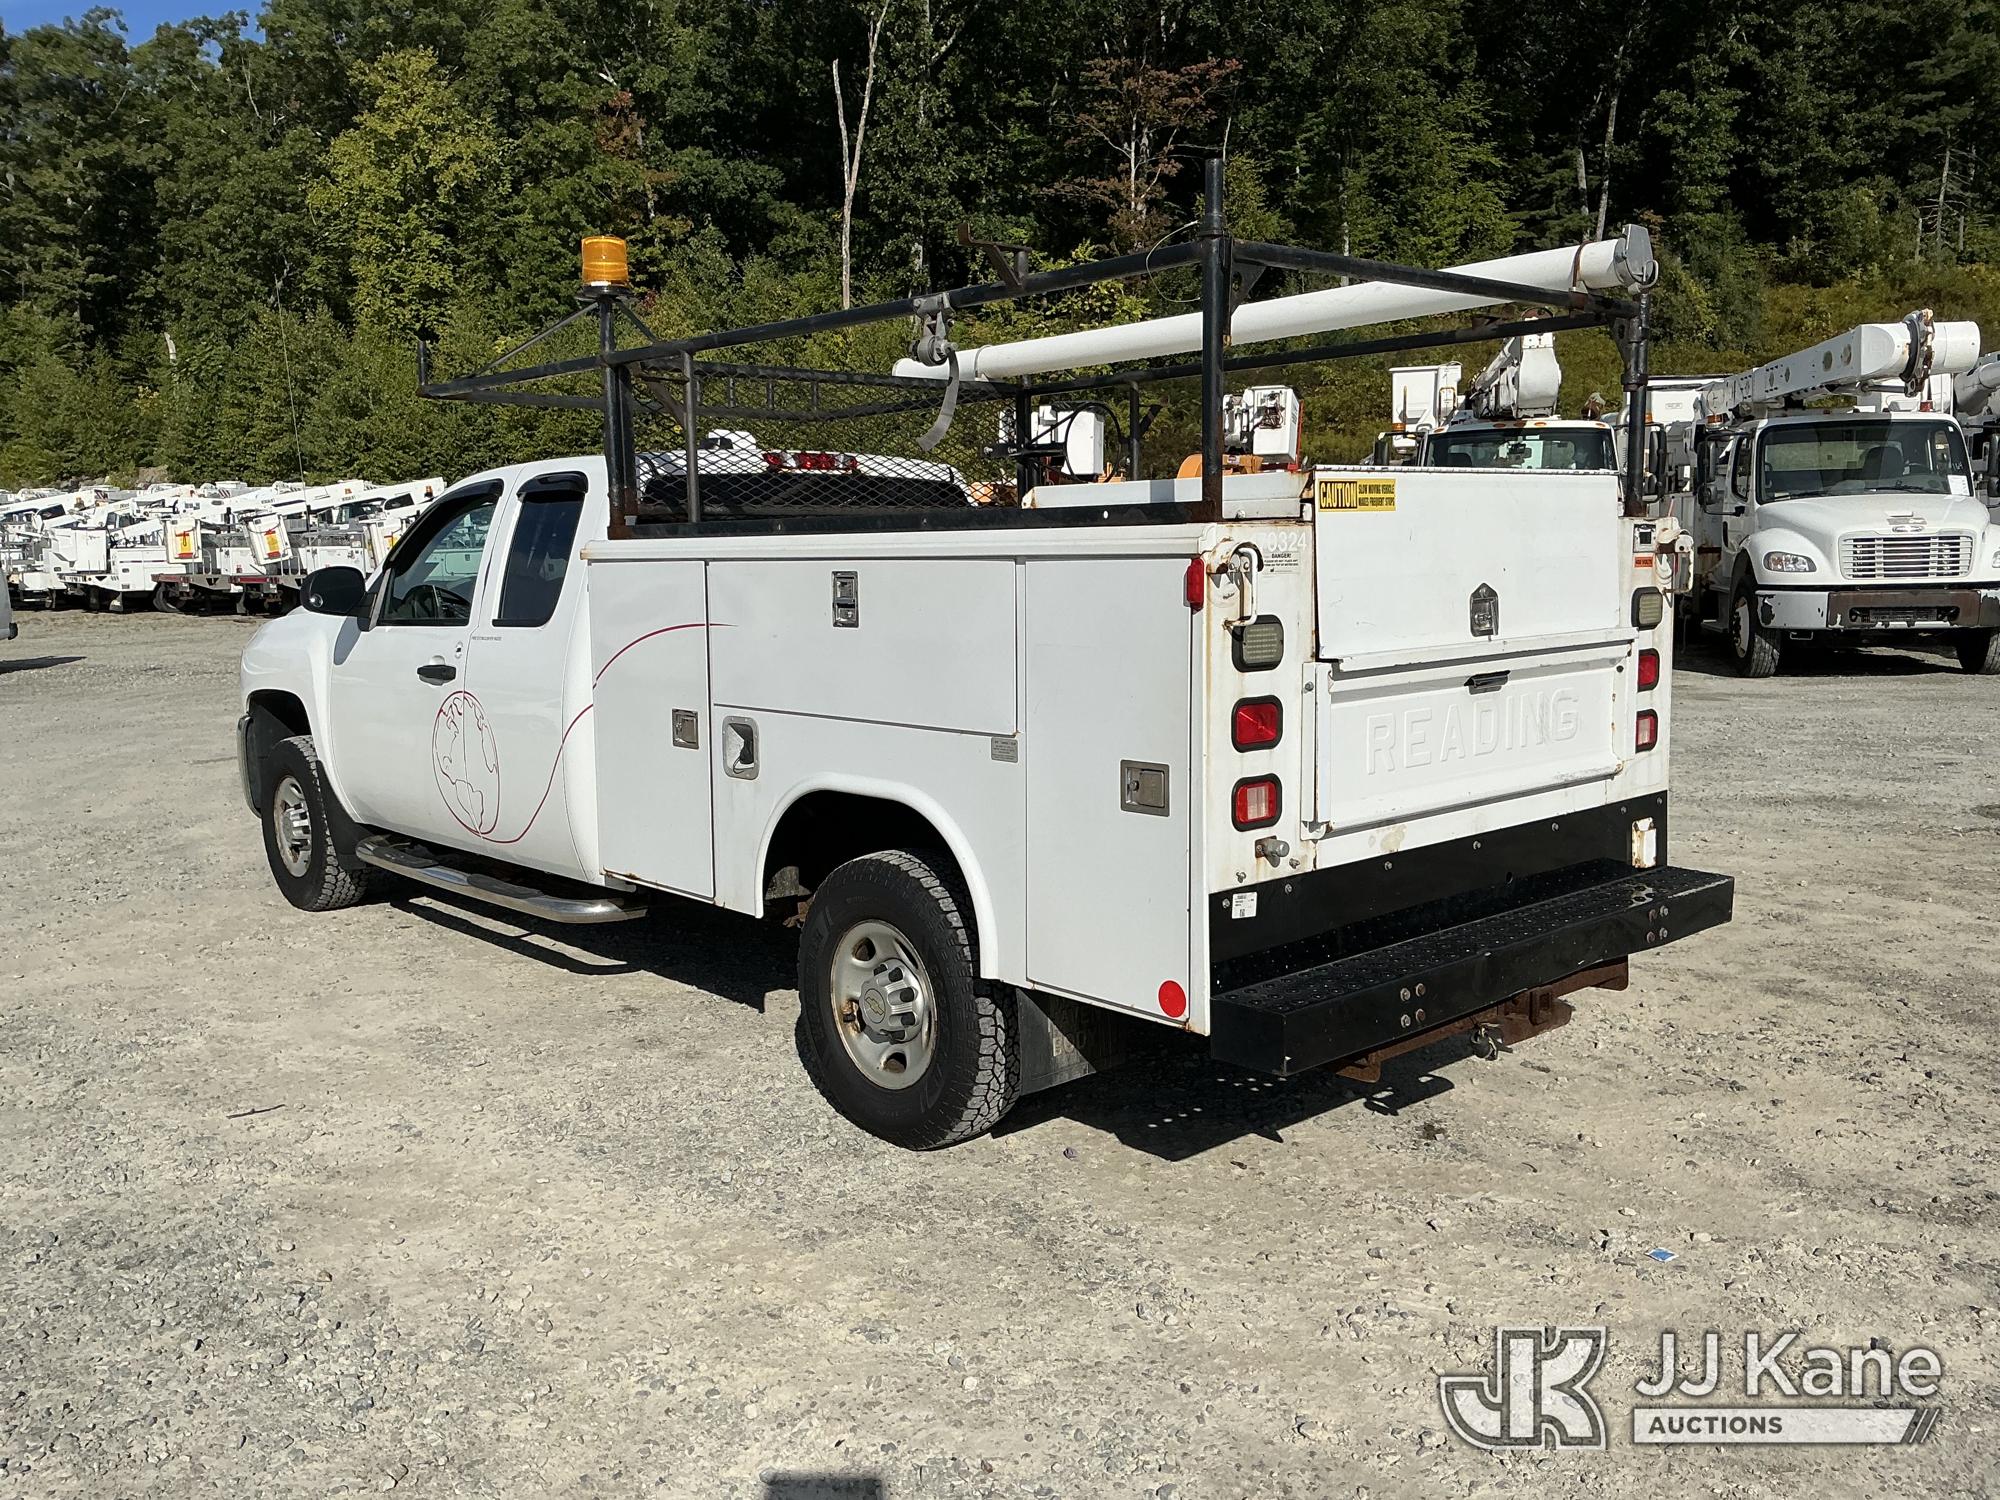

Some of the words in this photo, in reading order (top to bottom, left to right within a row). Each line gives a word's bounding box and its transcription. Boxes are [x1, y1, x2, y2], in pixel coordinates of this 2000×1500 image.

[1320, 482, 1357, 508] CAUTION
[1358, 484, 1367, 494] SLOW
[1368, 484, 1381, 494] MOVING
[1382, 484, 1395, 494] VEHICLE
[1366, 687, 1581, 775] READING
